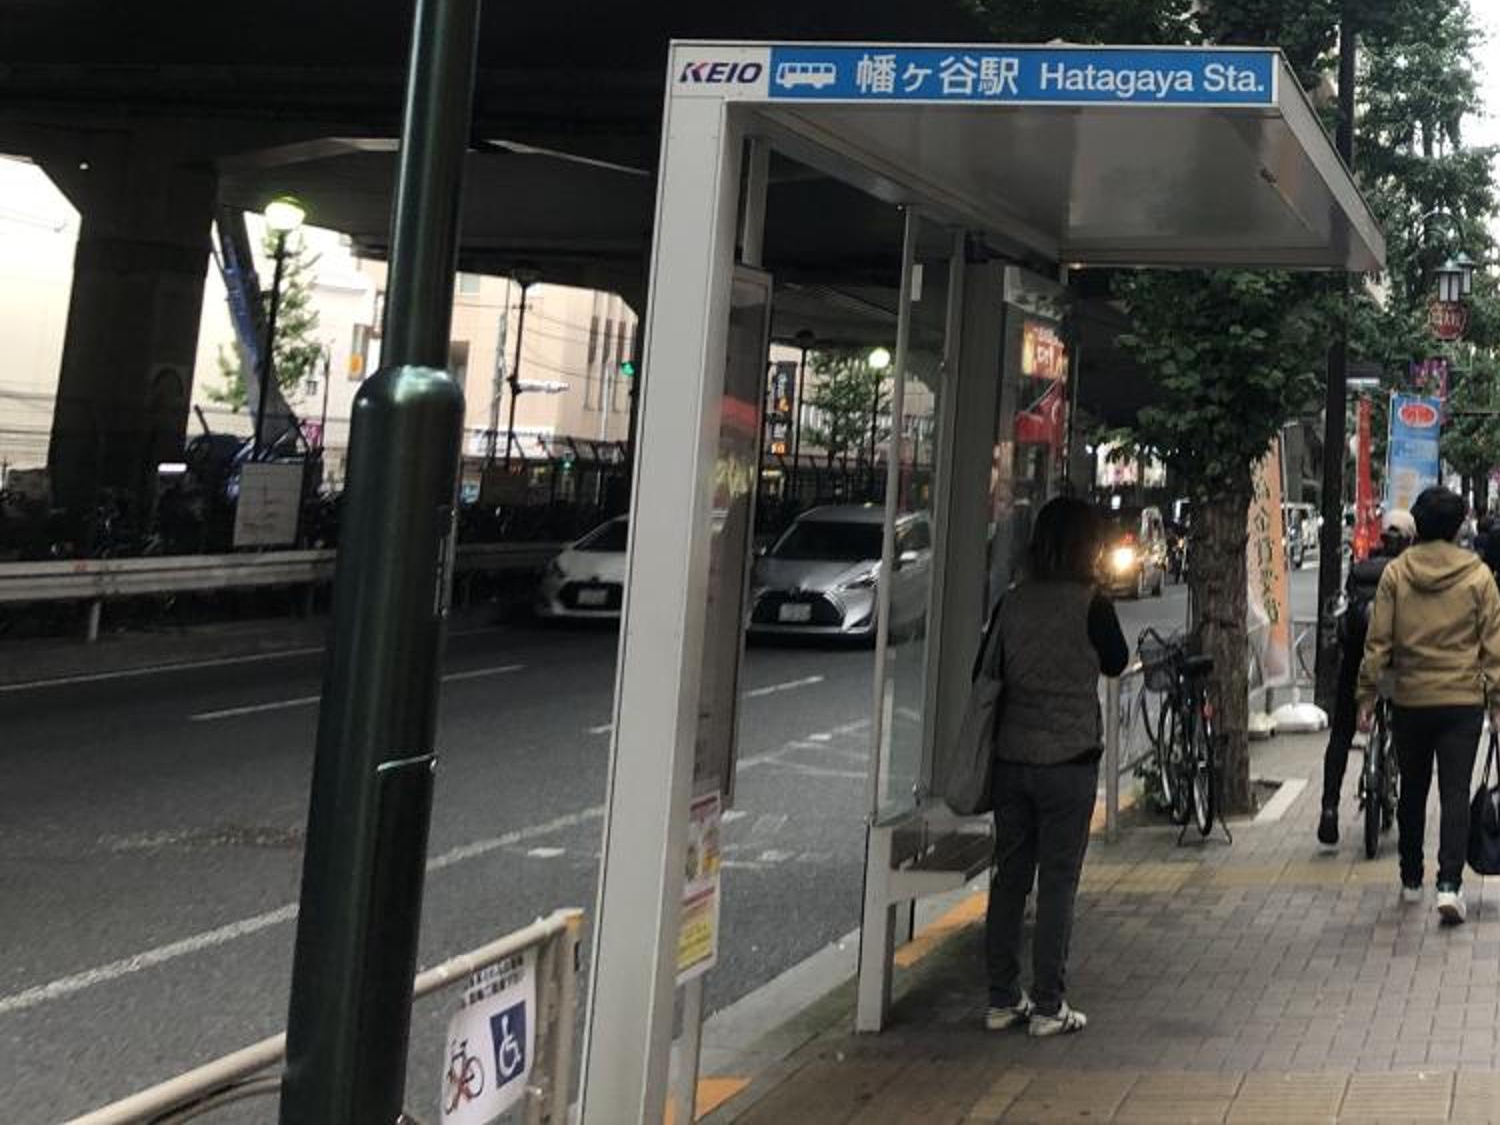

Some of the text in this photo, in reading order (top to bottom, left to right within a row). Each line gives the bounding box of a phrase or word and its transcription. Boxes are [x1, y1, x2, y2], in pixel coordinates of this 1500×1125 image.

[680, 62, 763, 84] KEIO
[855, 53, 1266, 99] 幡ヶ谷駅 Hatagaya Sta.
